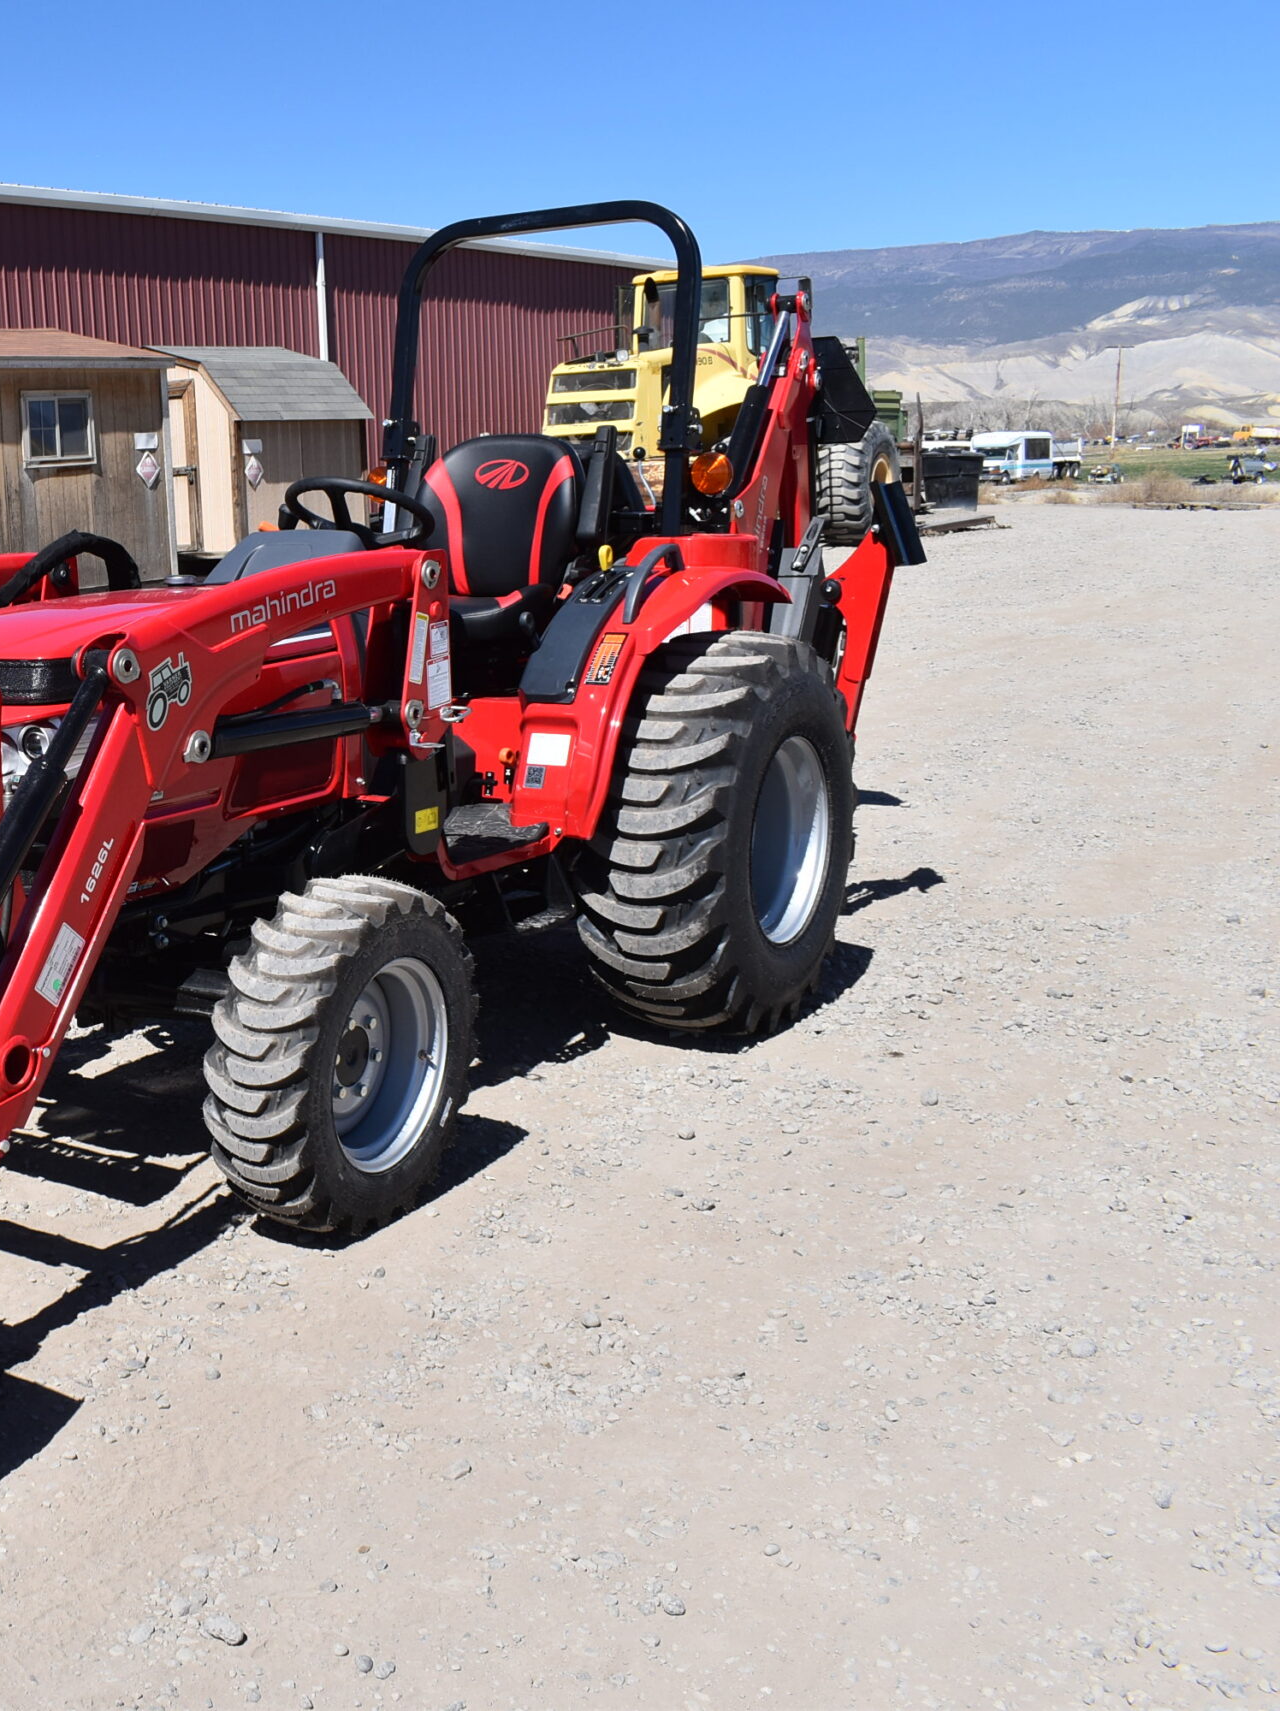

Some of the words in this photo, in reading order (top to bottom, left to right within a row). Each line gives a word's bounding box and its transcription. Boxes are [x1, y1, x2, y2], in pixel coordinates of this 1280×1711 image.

[754, 475, 768, 538] indra
[230, 579, 337, 633] mahindra
[80, 838, 114, 904] 1626L
